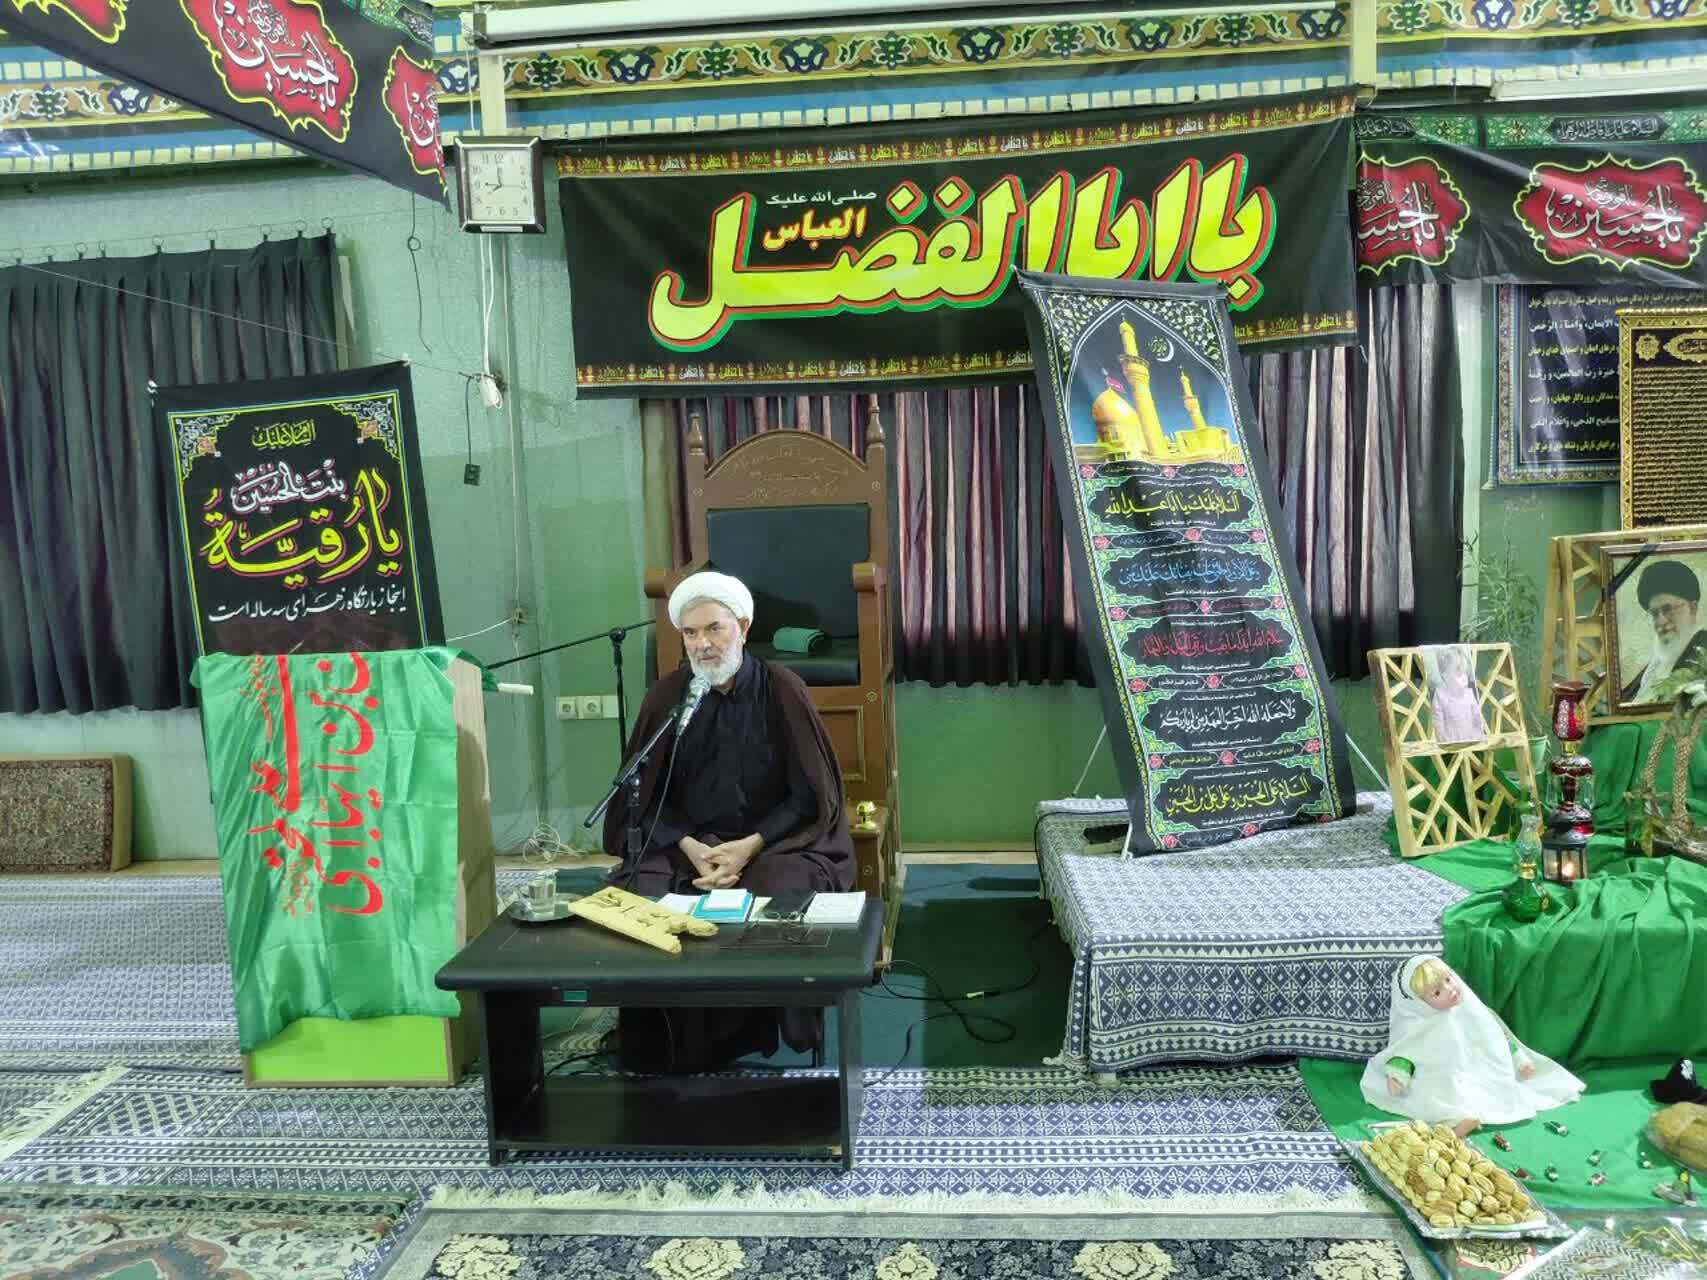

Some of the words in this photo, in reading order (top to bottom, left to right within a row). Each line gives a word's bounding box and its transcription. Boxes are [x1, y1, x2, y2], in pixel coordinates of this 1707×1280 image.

[766, 192, 808, 208] علیک
[811, 191, 831, 202] الله
[831, 189, 877, 205] صلی
[762, 205, 868, 252] العباس
[1186, 152, 1278, 312] یا
[287, 588, 346, 622] زهرای
[347, 585, 385, 615] زیارتگاه
[386, 584, 407, 612] اینجا
[208, 601, 249, 622] است
[250, 600, 273, 618] ساله
[273, 605, 287, 617] سه
